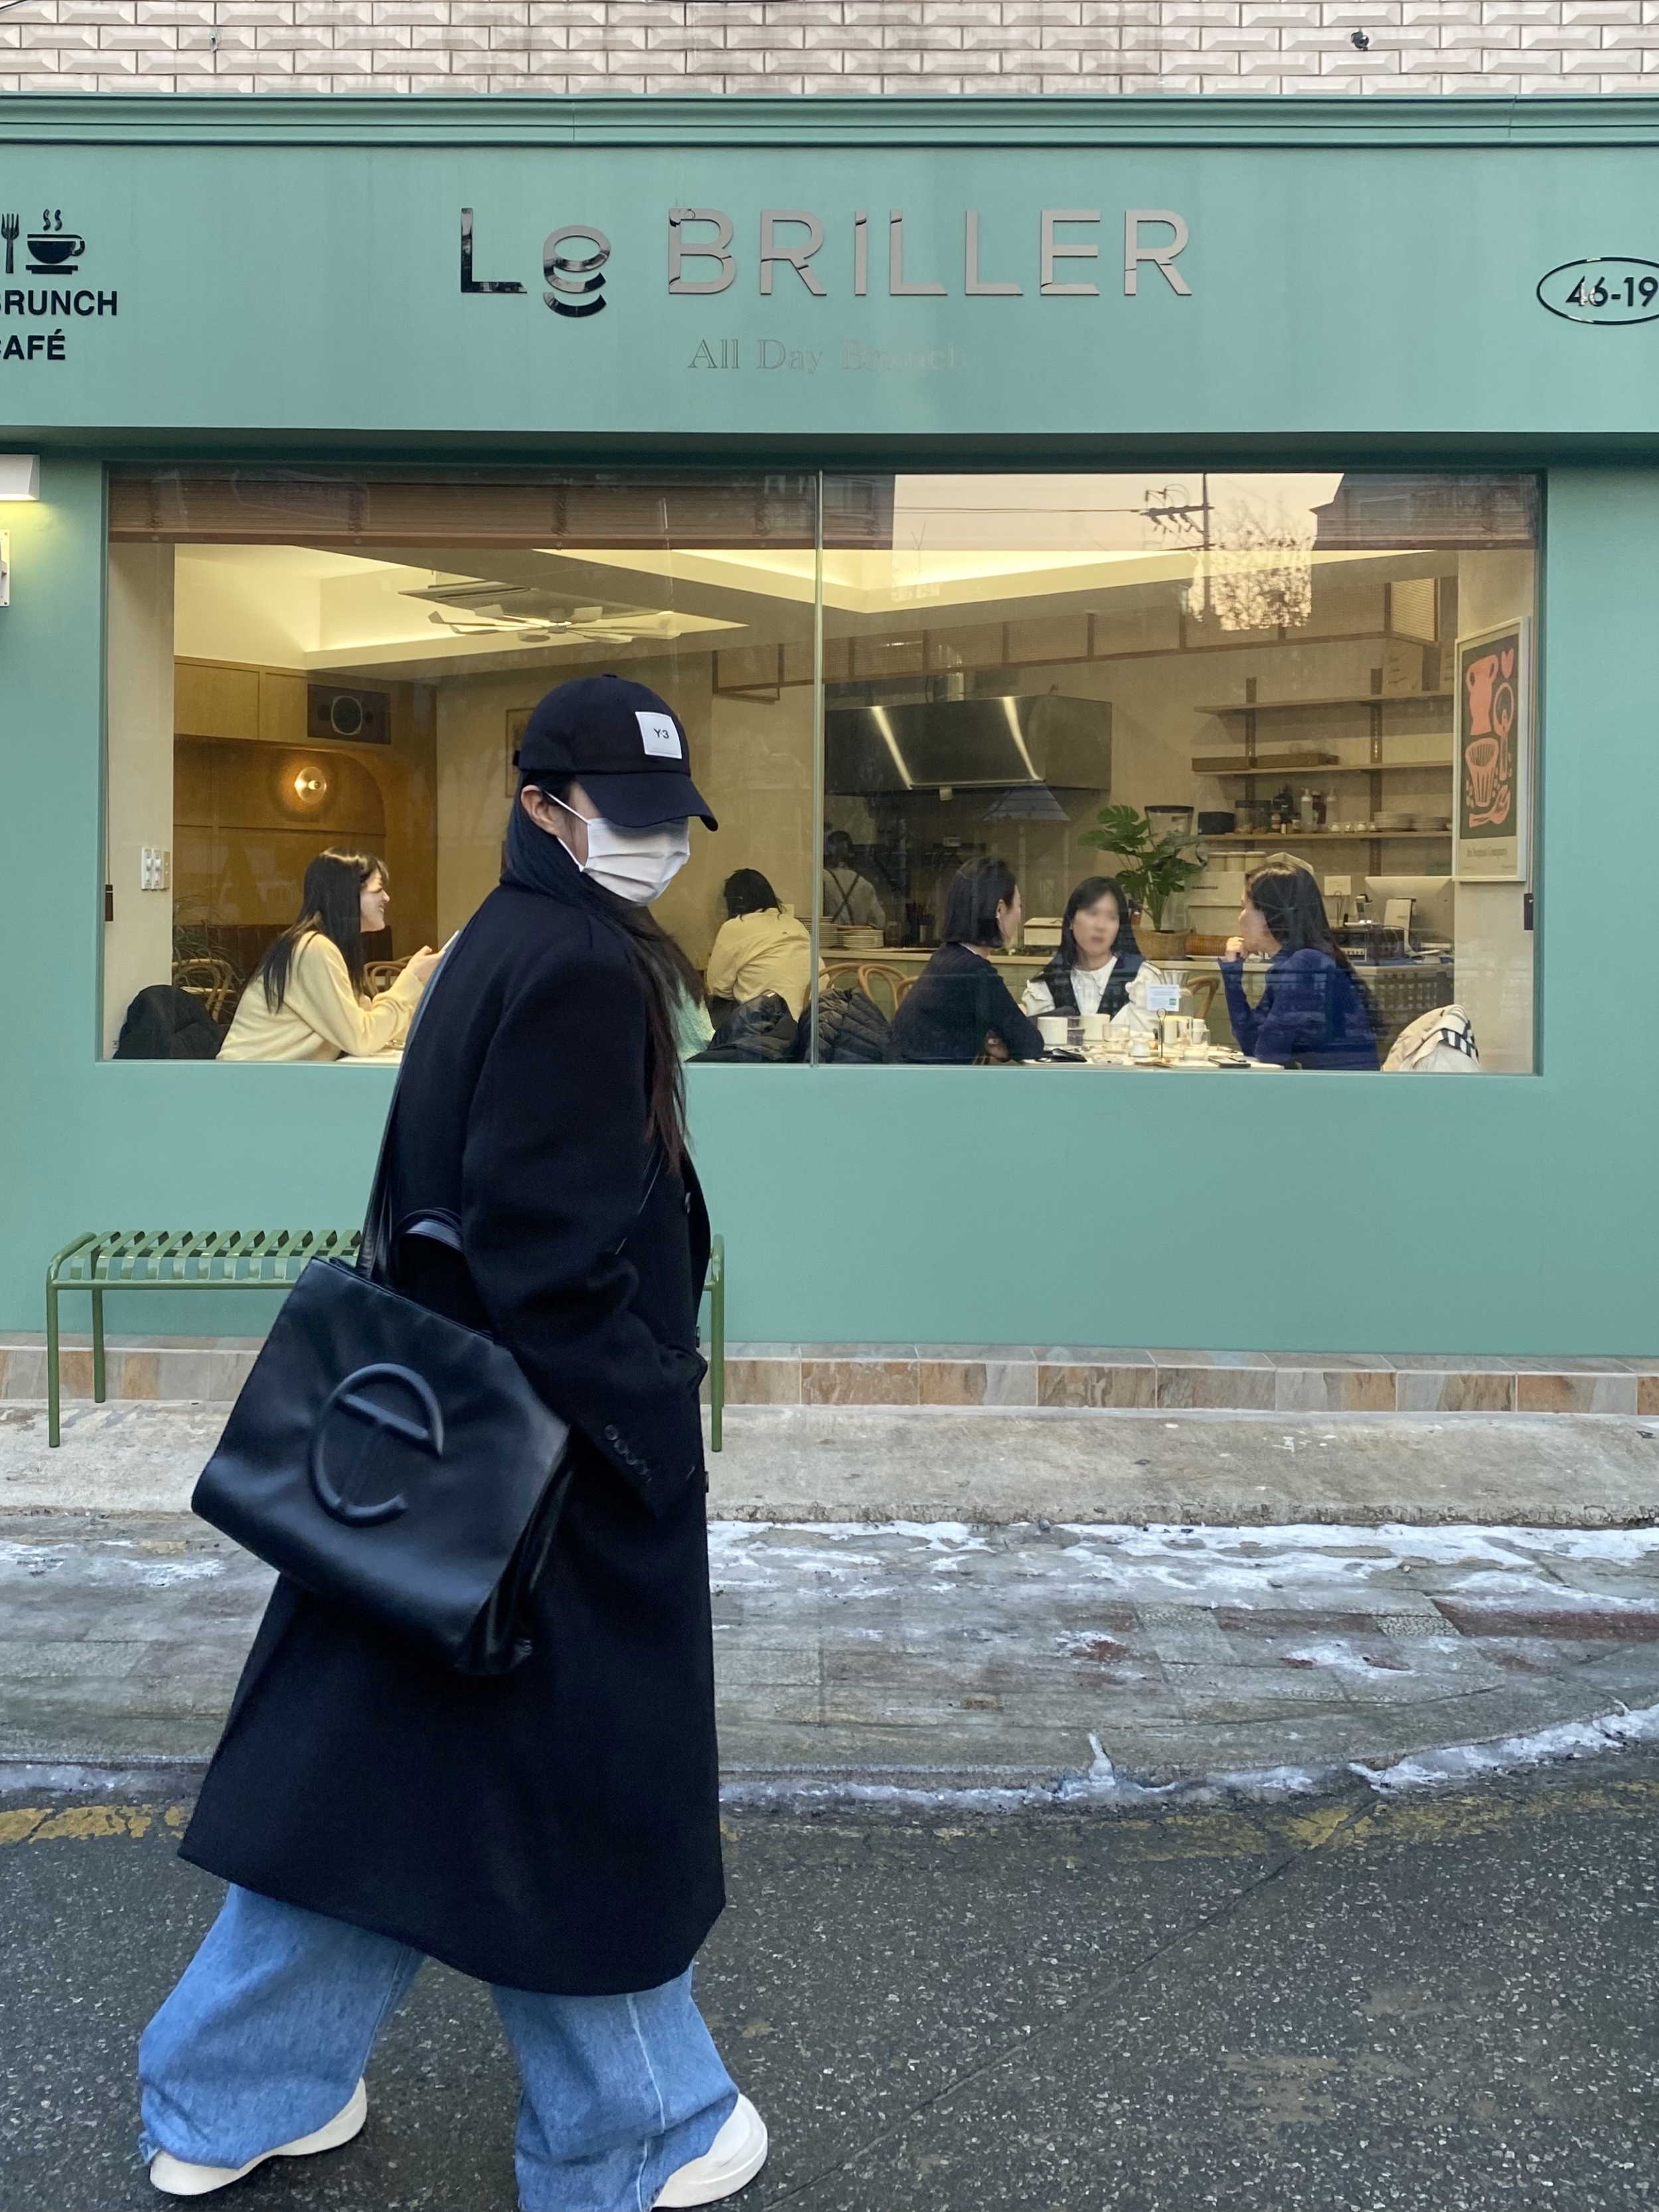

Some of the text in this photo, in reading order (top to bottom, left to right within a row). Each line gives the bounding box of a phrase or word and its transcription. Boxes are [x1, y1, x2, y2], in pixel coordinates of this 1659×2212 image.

[460, 207, 1193, 317] Le BRILLER
[0, 289, 118, 316] RUNCH
[1565, 276, 1659, 307] 46-19
[0, 329, 66, 360] AFÉ
[687, 337, 741, 369] All
[755, 338, 823, 375] Day
